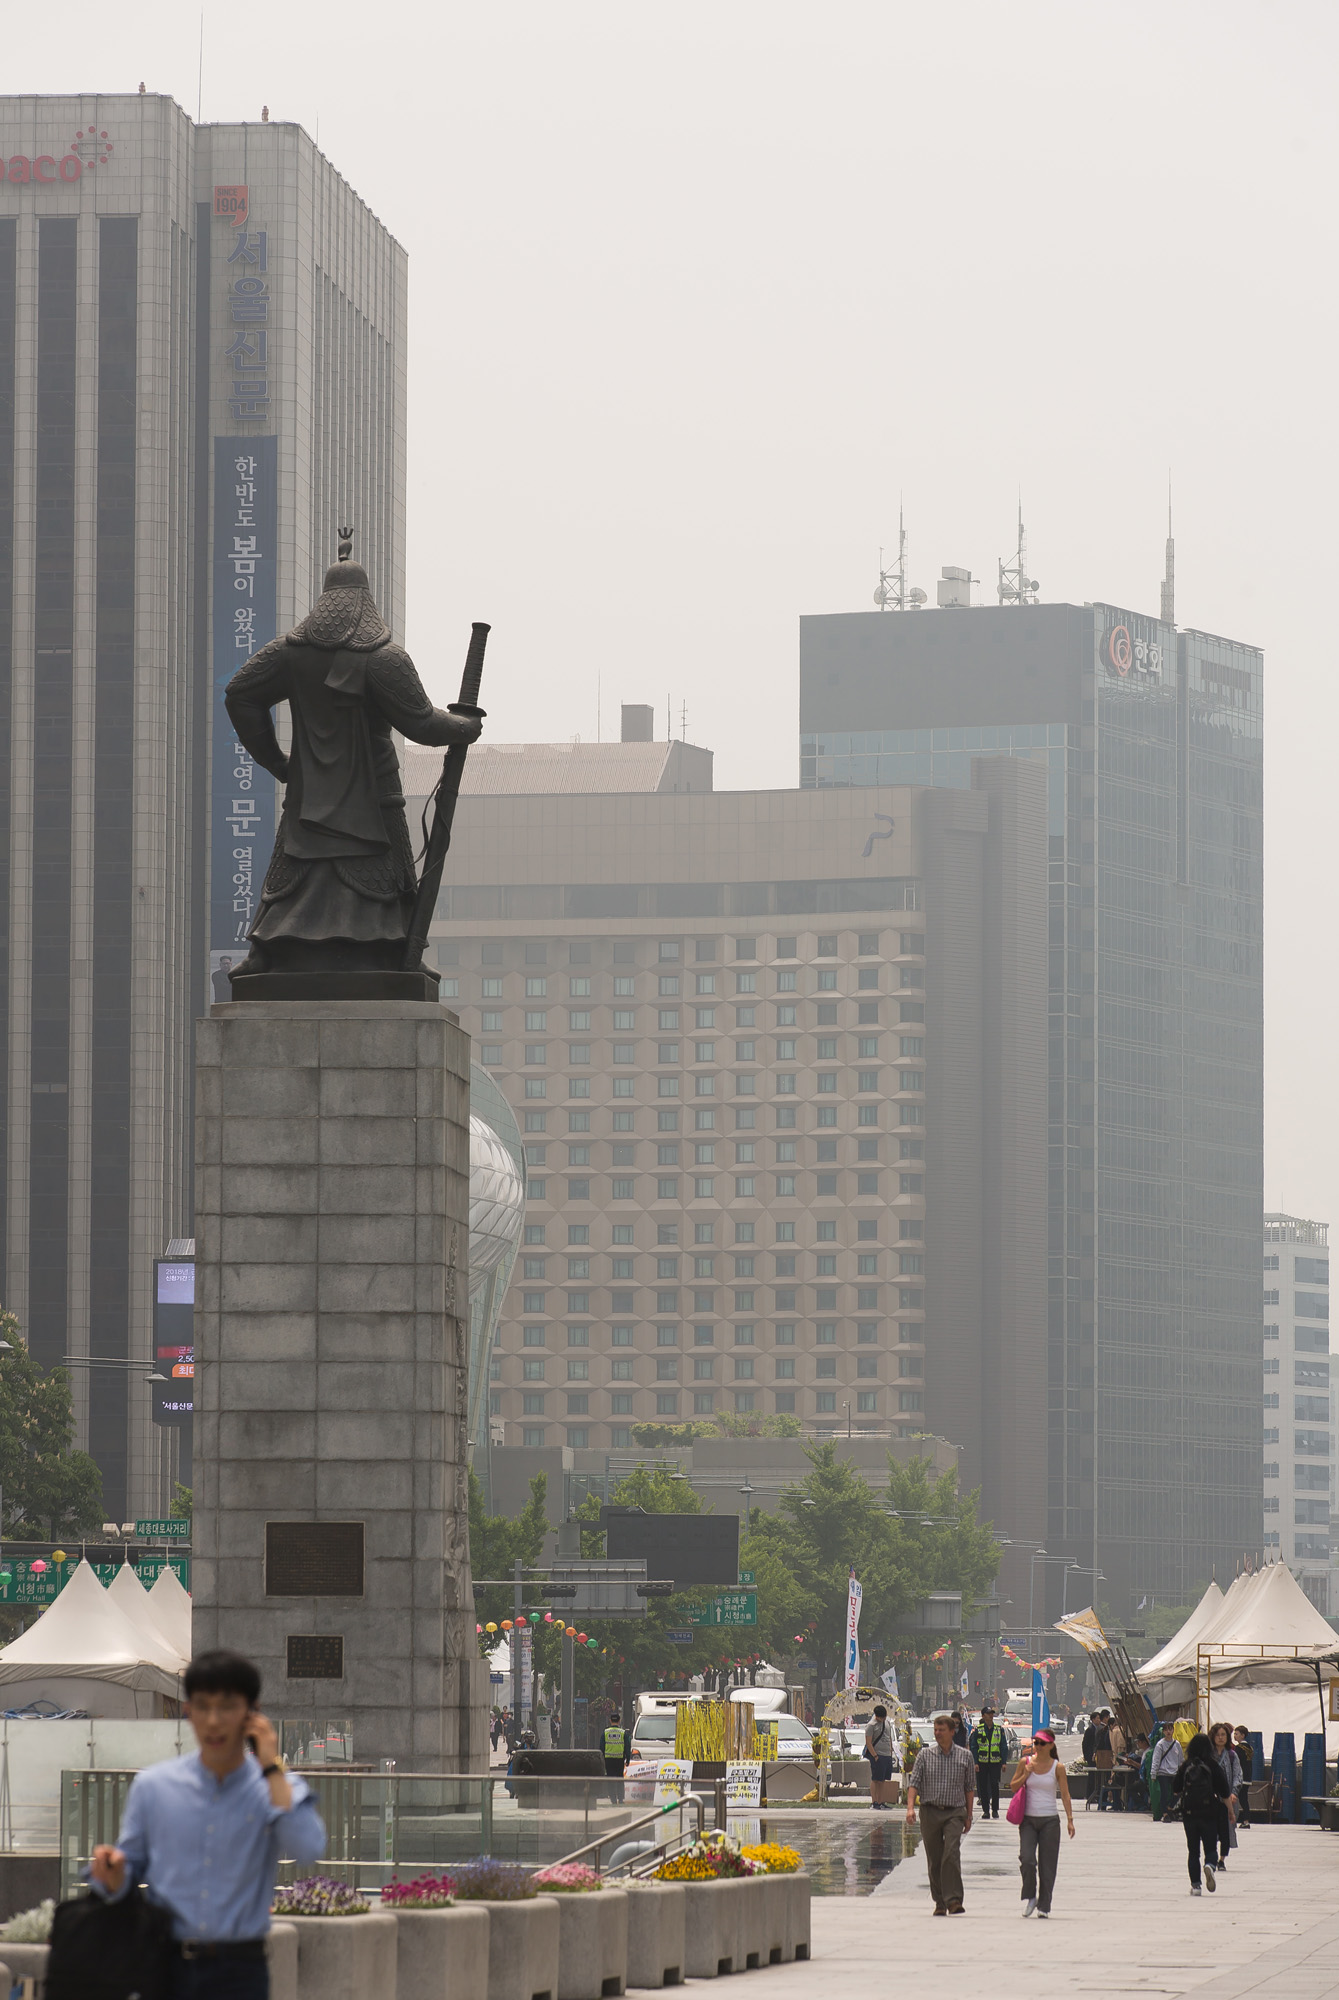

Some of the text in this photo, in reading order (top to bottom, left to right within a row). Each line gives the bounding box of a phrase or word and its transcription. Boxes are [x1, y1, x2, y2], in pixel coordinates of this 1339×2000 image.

[0, 154, 83, 184] aco
[216, 187, 239, 197] SINCE
[216, 197, 247, 213] 1904
[225, 230, 271, 421] 서울신문
[227, 455, 263, 655] 한반도 봄이 왔다
[1133, 636, 1164, 678] 한화
[225, 799, 262, 837] 문
[137, 1522, 187, 1536] 세종대로사거리
[15, 1561, 53, 1573] 숭문
[15, 1583, 35, 1595] 시청
